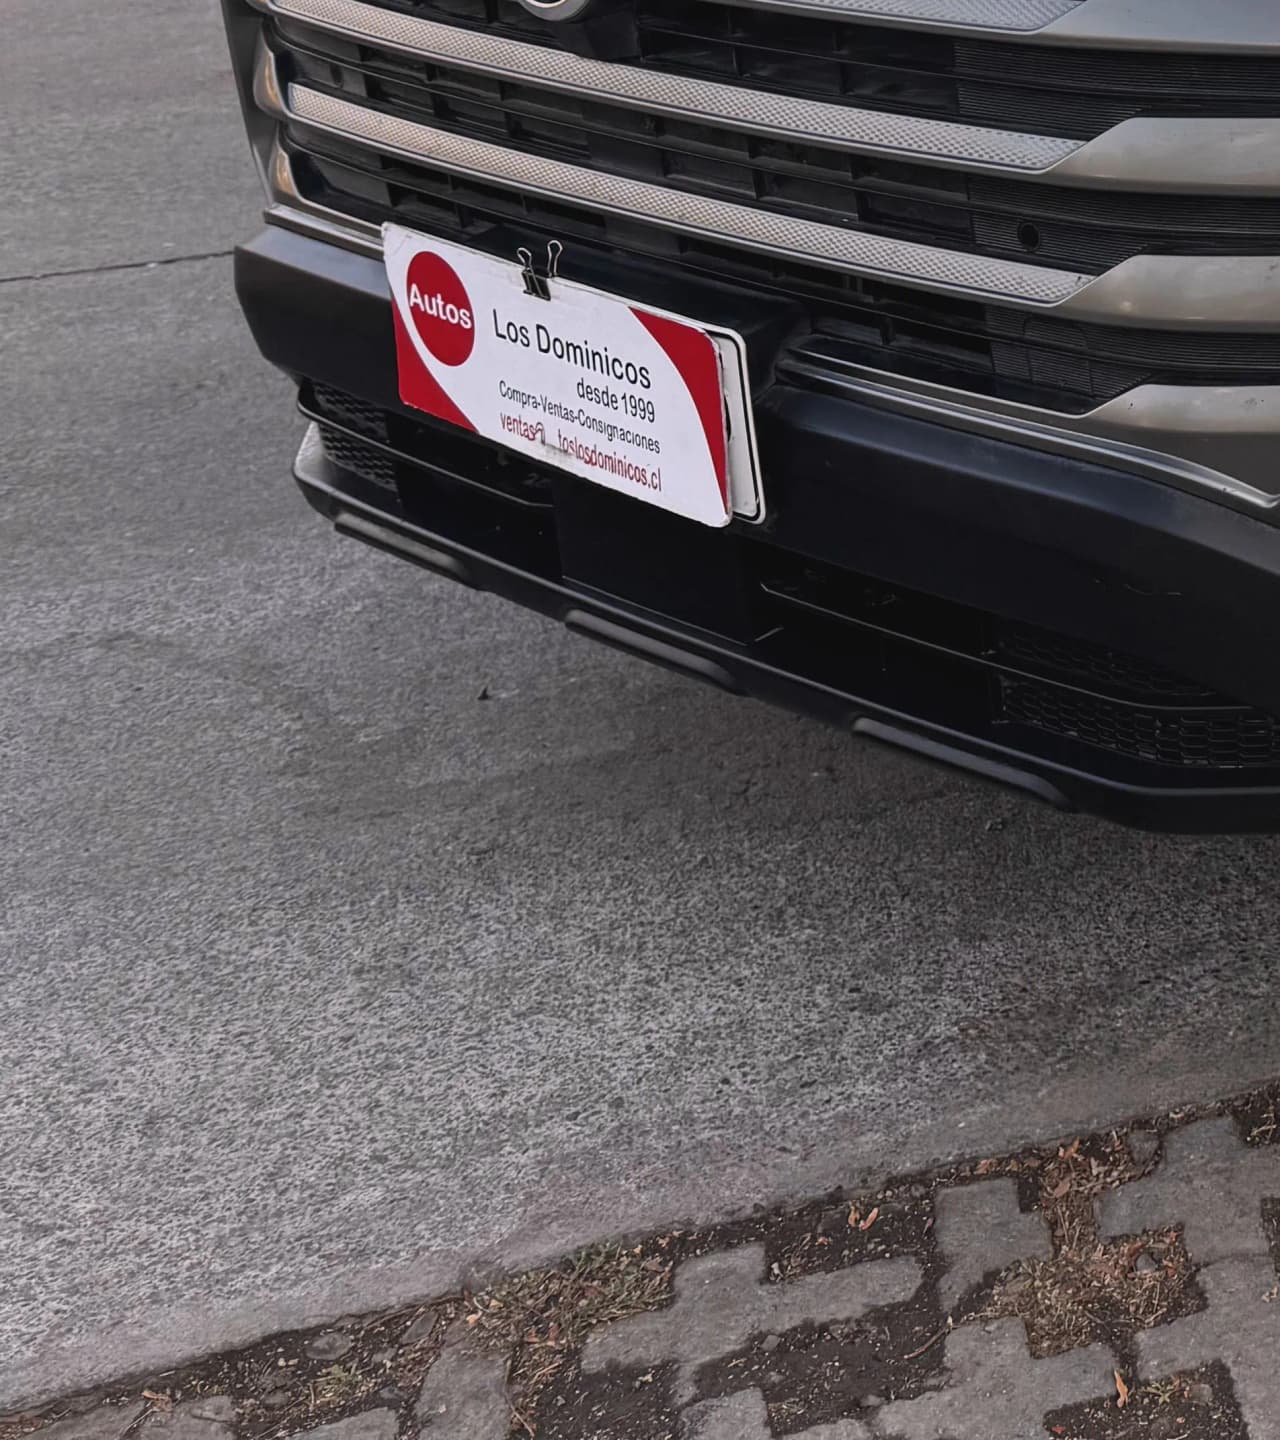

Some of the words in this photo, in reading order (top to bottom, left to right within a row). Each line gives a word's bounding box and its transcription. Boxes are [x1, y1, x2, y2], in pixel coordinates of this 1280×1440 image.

[408, 283, 473, 330] Autos
[492, 307, 531, 349] Los
[536, 323, 652, 390] Dominicos
[576, 377, 619, 411] desde
[620, 392, 656, 424] 1999
